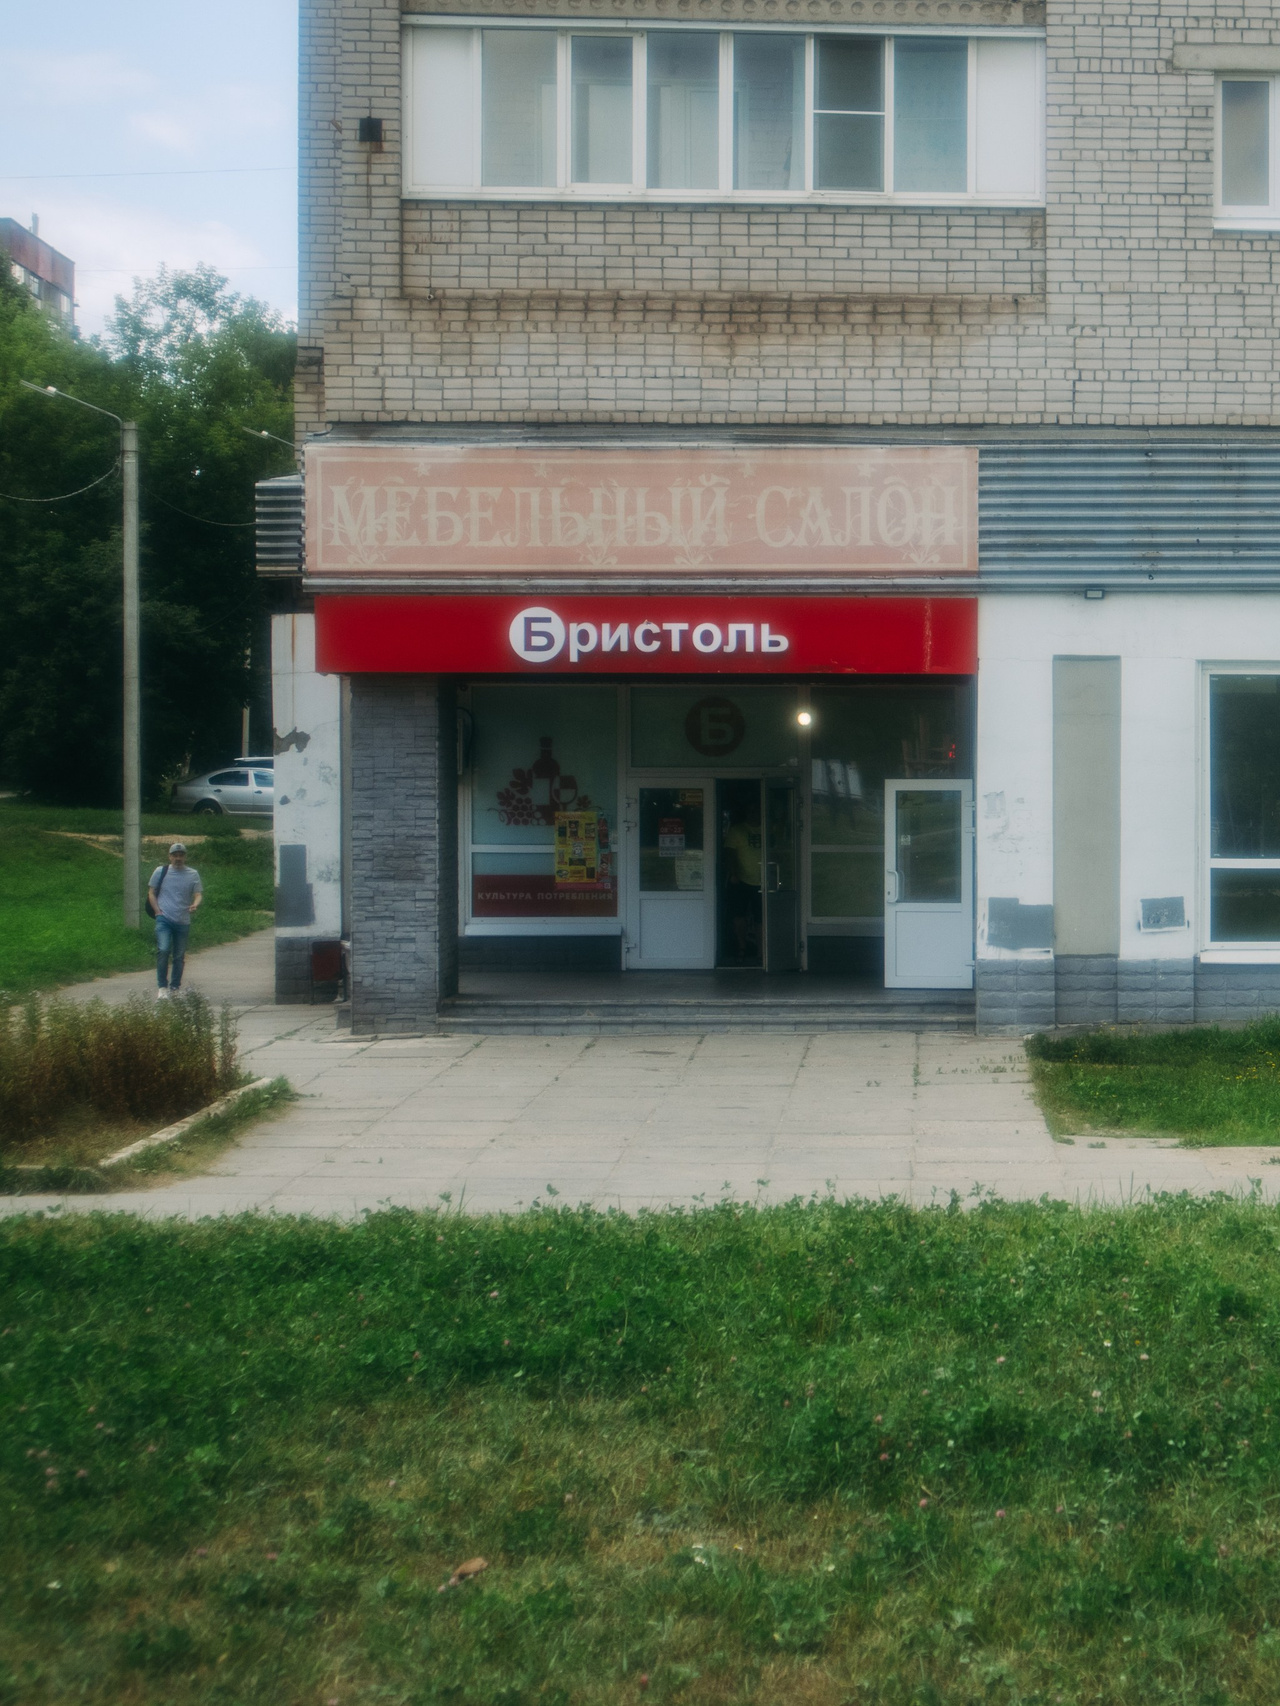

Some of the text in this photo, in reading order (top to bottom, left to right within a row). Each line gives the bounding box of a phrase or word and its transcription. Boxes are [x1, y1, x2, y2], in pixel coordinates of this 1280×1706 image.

[328, 475, 959, 548] МЕБЕЛЬНЫЙ САЛОН
[521, 616, 790, 663] Бристоль
[700, 707, 735, 746] Б
[477, 891, 614, 900] КУЛЬТУРА ПОТРЕБЛЕНИЯ
